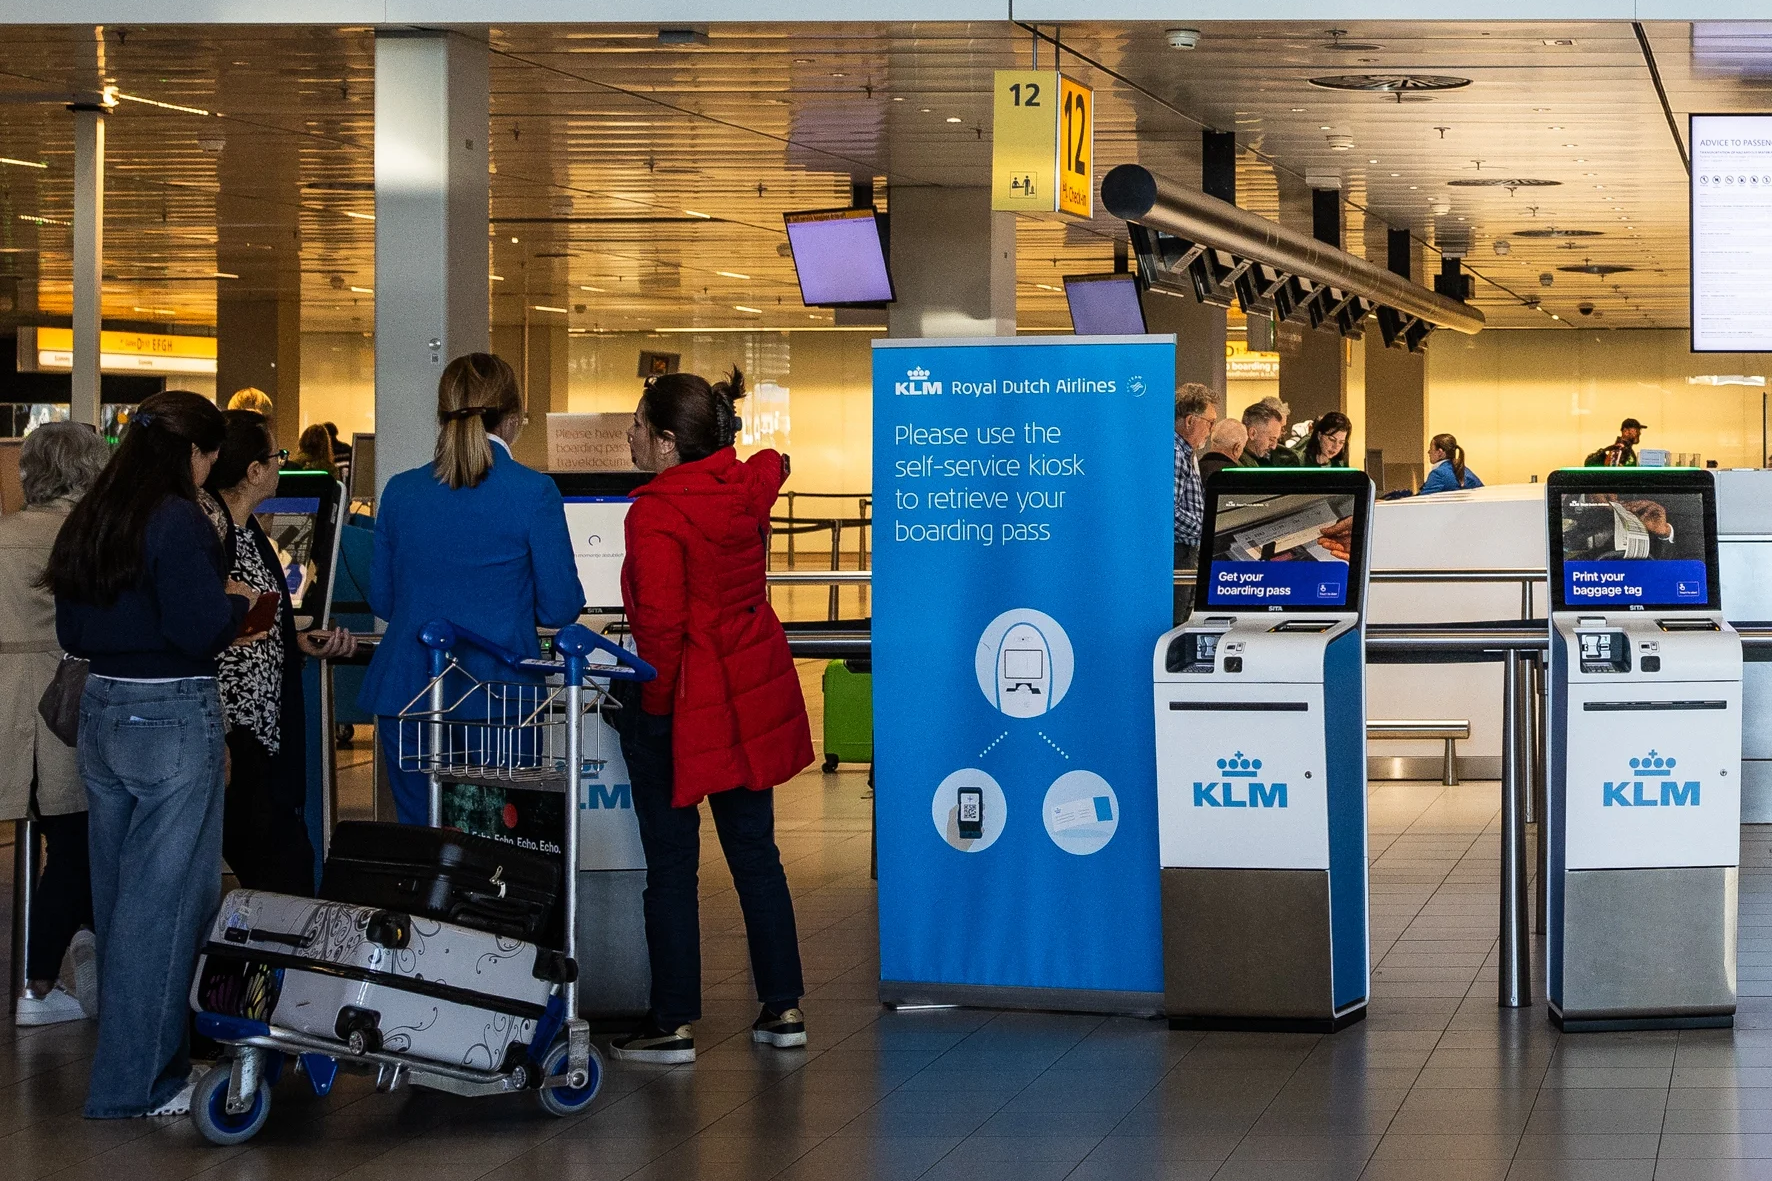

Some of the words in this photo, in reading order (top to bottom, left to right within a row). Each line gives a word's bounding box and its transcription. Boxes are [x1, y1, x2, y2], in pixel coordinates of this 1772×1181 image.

[1009, 83, 1040, 106] 12
[1065, 91, 1085, 176] 12
[1069, 186, 1086, 207] Check-in
[1232, 362, 1270, 372] boarding
[895, 381, 942, 395] KLM
[952, 380, 997, 397] Royal
[1003, 379, 1050, 394] Dutch
[1056, 379, 1116, 394] Airlines
[555, 429, 592, 438] Please
[595, 429, 622, 439] have
[895, 423, 968, 445] Please
[977, 427, 1016, 444] use
[1024, 422, 1061, 444] the
[556, 443, 602, 453] boarding
[605, 444, 630, 453] pass
[895, 455, 1020, 477] self-service
[1029, 454, 1085, 476] kiosk
[895, 489, 919, 509] to
[928, 488, 1009, 509] retrieve
[1016, 491, 1066, 513] your
[895, 520, 993, 546] boarding
[1003, 523, 1050, 545] pass
[1219, 572, 1237, 582] Get
[1239, 573, 1264, 583] your
[1573, 572, 1598, 581] Print
[1600, 572, 1625, 583] your
[1217, 586, 1264, 597] boarding
[1266, 587, 1291, 597] pass
[1573, 586, 1622, 597] baggage
[1624, 586, 1642, 597] tag
[1193, 781, 1289, 809] KLM
[1603, 781, 1701, 807] KLM
[517, 837, 538, 850] Echo.
[540, 840, 561, 854] Echo.
